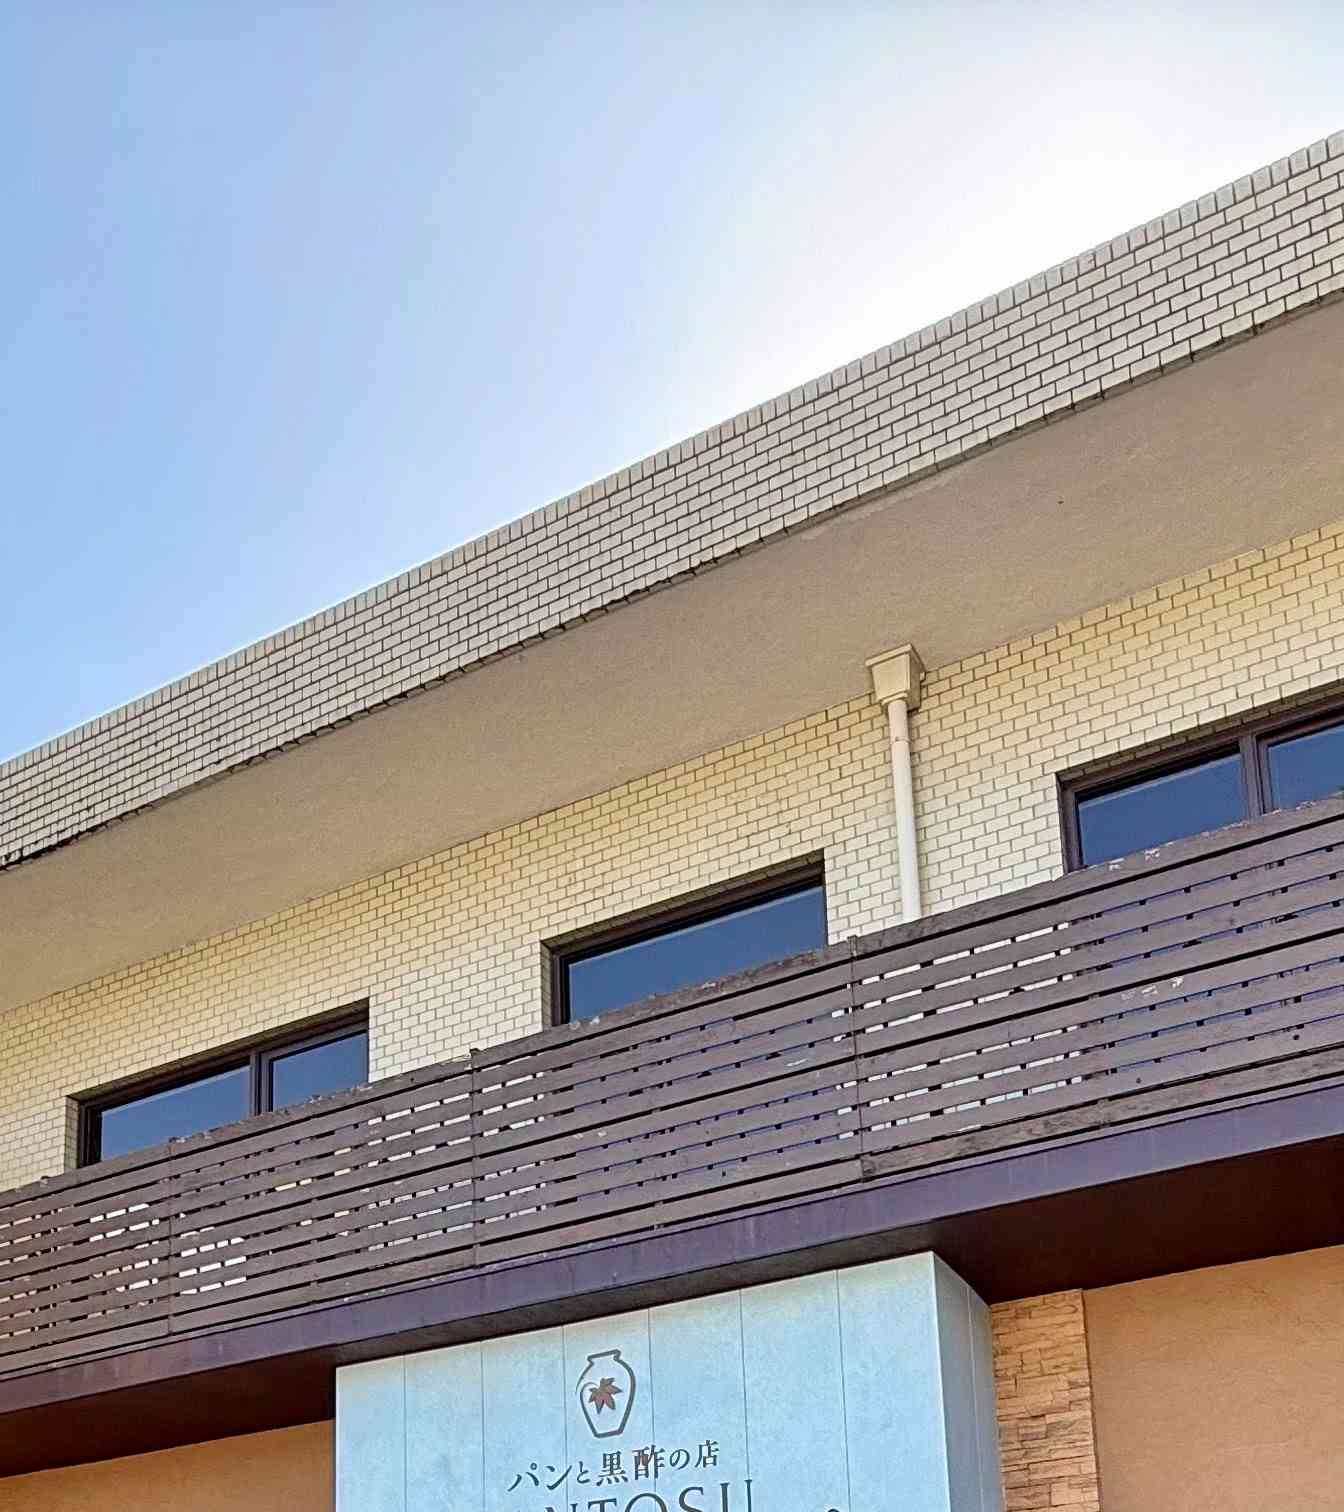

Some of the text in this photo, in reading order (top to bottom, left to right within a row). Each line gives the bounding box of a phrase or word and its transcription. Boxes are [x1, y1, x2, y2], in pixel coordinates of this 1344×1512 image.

[507, 1440, 720, 1492] パンと黒酢の店
